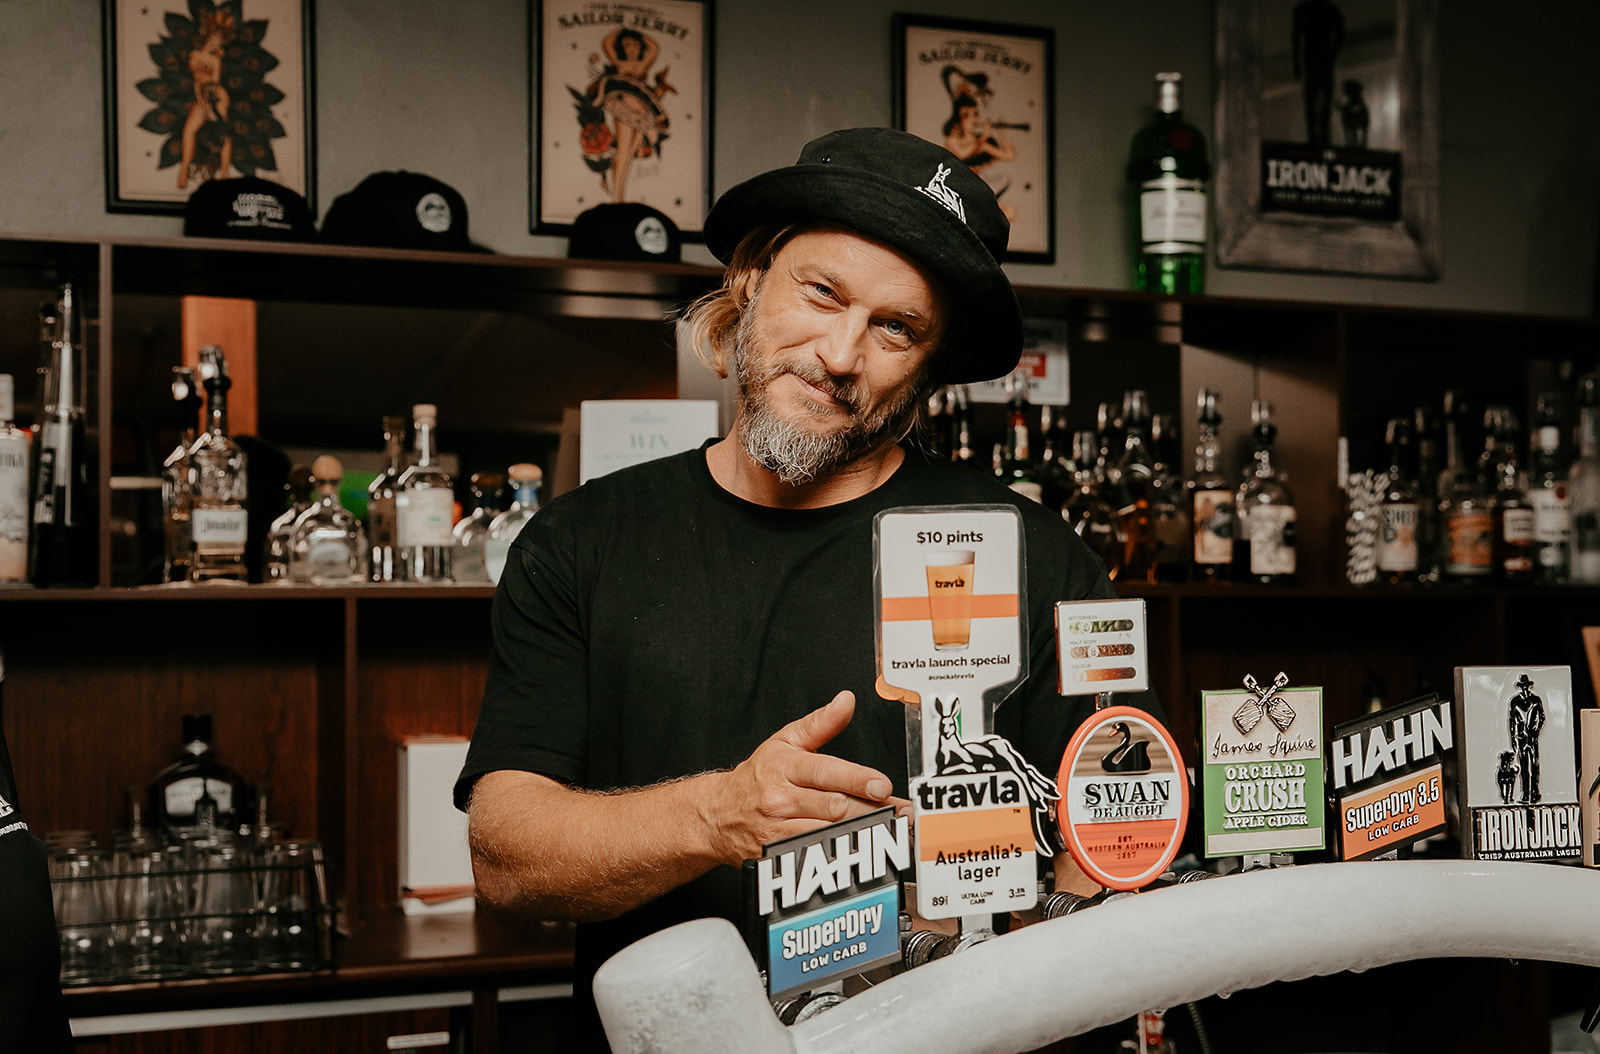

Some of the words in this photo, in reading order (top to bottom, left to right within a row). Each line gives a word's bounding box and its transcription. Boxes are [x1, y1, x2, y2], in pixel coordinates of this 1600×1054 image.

[558, 10, 624, 28] SAILOR
[633, 14, 689, 40] JERRY
[1266, 159, 1328, 190] IRON
[1330, 164, 1393, 196] JACK
[917, 531, 943, 545] $10
[947, 530, 983, 546] pints
[892, 658, 926, 669] travla
[929, 656, 967, 668] launch
[970, 654, 1011, 667] special
[1213, 733, 1263, 759] James
[1267, 732, 1317, 757] Squire
[1332, 701, 1453, 789] HAHN
[1225, 763, 1306, 781] ORCHARD
[917, 775, 1020, 810] travla
[1084, 779, 1170, 806] SWAN
[1224, 778, 1307, 813] CRUSH
[1346, 788, 1416, 832] SuperDry
[1418, 777, 1440, 806] 3.5
[1092, 805, 1166, 819] DRAUGHT
[1224, 815, 1265, 830] APPLE
[1267, 814, 1308, 828] CIDER
[1368, 824, 1390, 841] LOW
[1392, 814, 1420, 832] CARB
[1478, 808, 1529, 852] IRON
[1529, 806, 1582, 850] JACK
[935, 843, 1022, 866] Australia's
[1087, 844, 1122, 852] WESTERN
[1126, 841, 1166, 850] AUSTRALIA
[1478, 851, 1503, 860] CRISP
[1505, 849, 1553, 860] AUSTRALIAN
[1556, 848, 1581, 856] LAGER
[757, 815, 910, 916] HAHN
[958, 865, 1001, 882] lager
[980, 890, 994, 898] LOW
[782, 903, 883, 960] SuperDry
[801, 953, 830, 973] LOW
[832, 941, 868, 962] CARB
